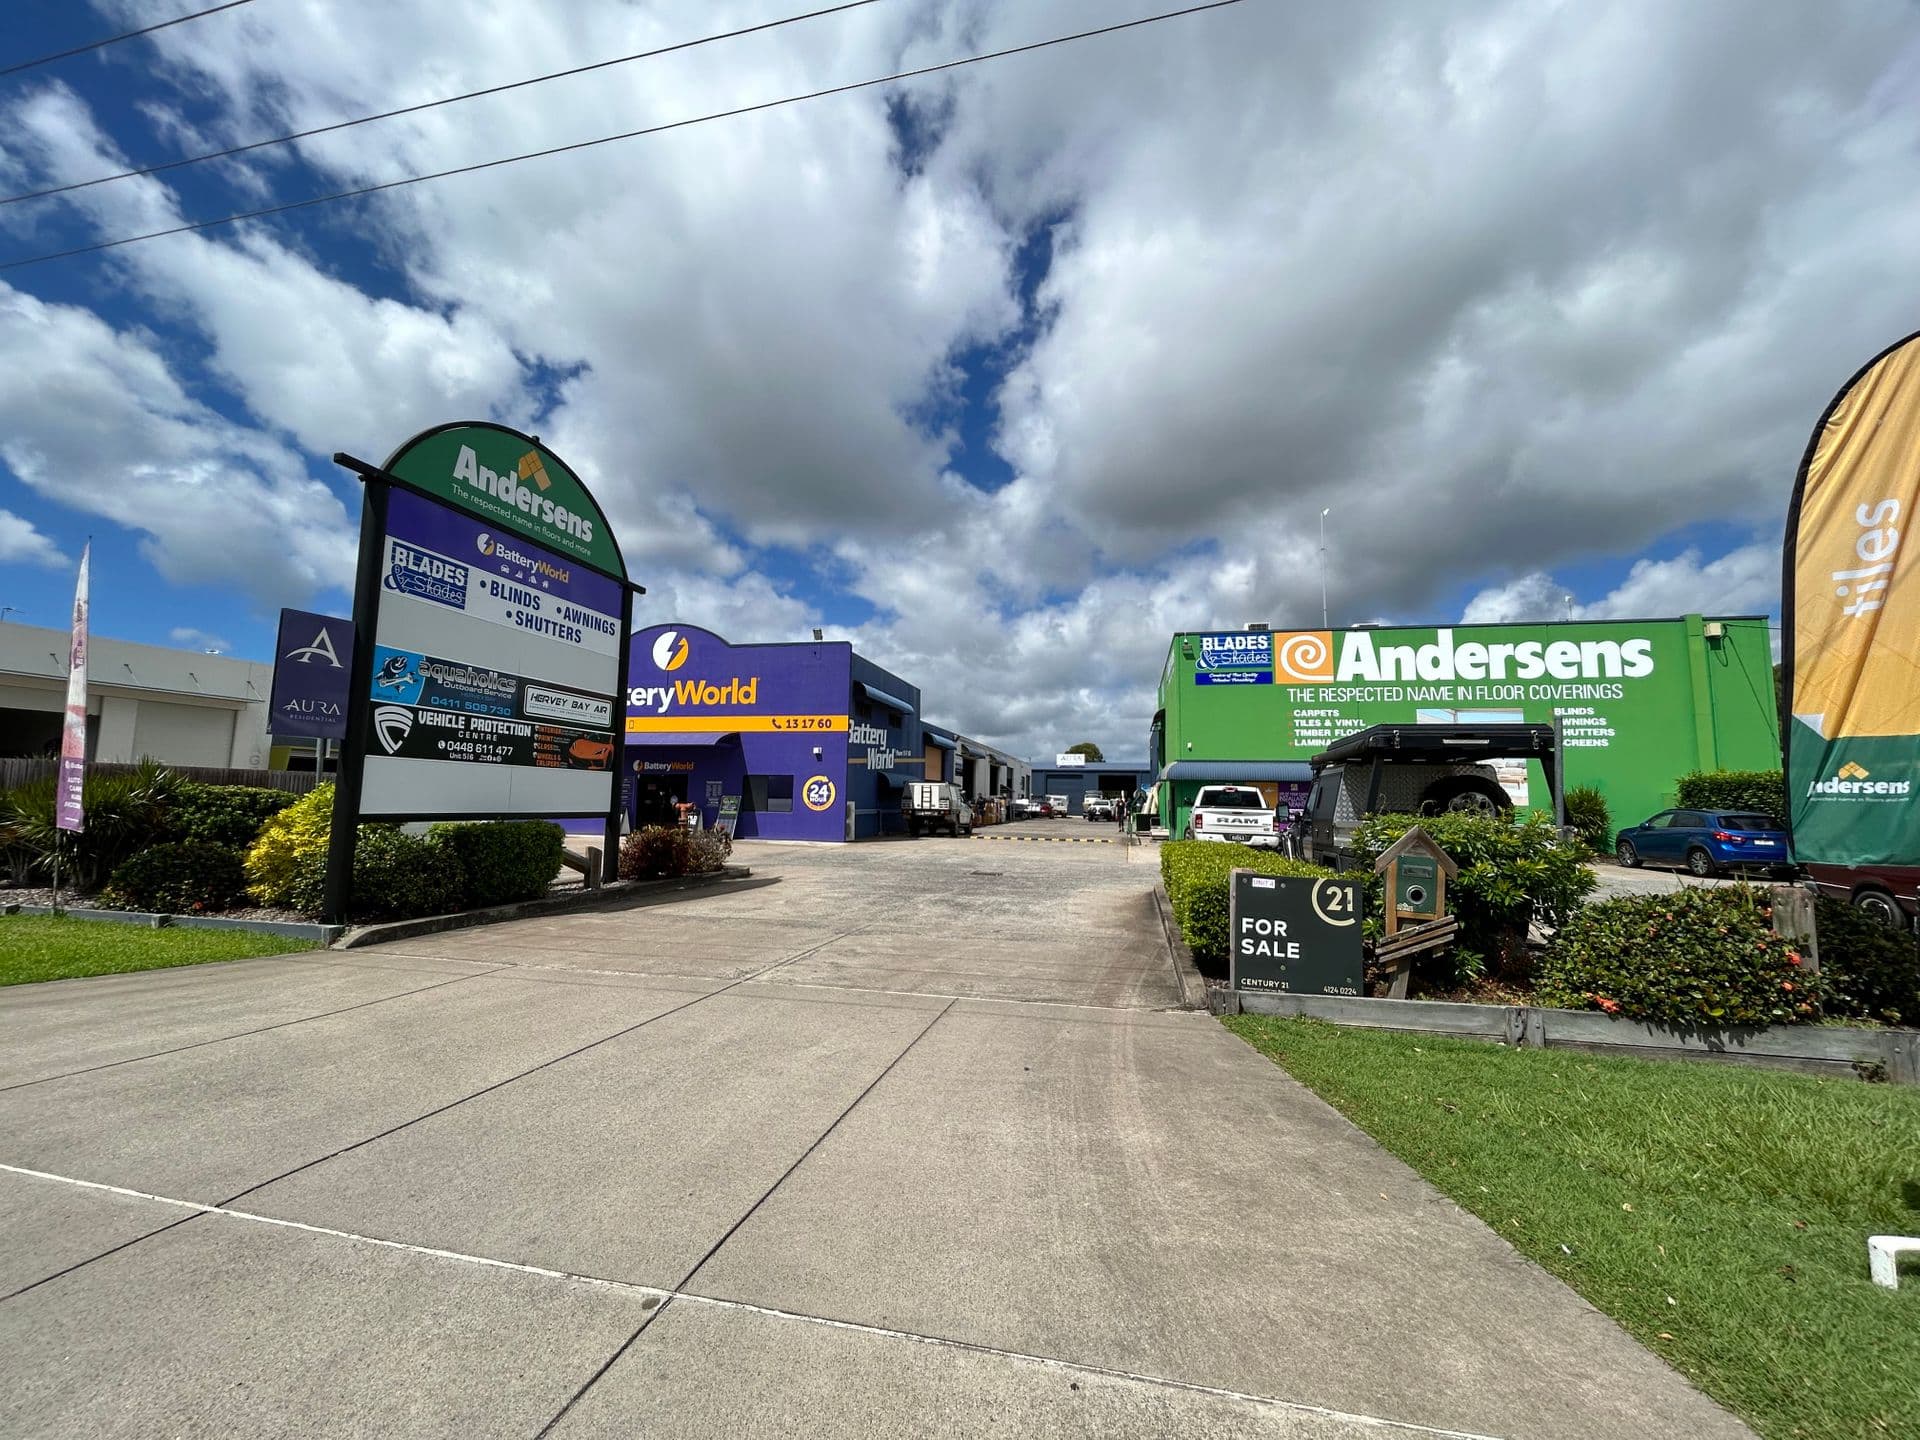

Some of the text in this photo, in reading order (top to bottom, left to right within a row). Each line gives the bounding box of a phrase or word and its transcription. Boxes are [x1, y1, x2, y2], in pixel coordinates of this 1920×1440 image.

[453, 444, 593, 542] Andersens
[452, 484, 592, 556] The respected name in floors and more
[394, 545, 466, 586] BLADES
[496, 543, 569, 583] BatteryWorld
[1832, 498, 1900, 618] tiles
[384, 563, 463, 603] & Shades
[490, 579, 616, 636] BLINDS AWNINGS
[515, 610, 582, 643] SHUTTERS
[1202, 635, 1268, 650] BLADES
[1195, 649, 1268, 671] & Shades
[1336, 628, 1654, 682] Andersens
[418, 661, 517, 693] aquaholics
[443, 681, 483, 694] Outboard
[483, 688, 512, 699] Service
[1287, 683, 1623, 703] THE RESPECTED NAME IN FLOOR COVERINGS
[282, 698, 341, 716] AURA
[431, 696, 460, 708] 0411
[464, 701, 488, 712] 509
[489, 705, 511, 716] 730
[530, 693, 568, 707] HERVEY
[571, 701, 590, 711] BAY
[593, 705, 608, 714] AIR
[1293, 709, 1339, 717] CARPETS
[1554, 707, 1595, 716] BLINDS
[418, 710, 532, 737] VEHICLE PROTECTION
[785, 718, 832, 729] 13 17 60
[1293, 719, 1366, 727] TILES & VINYL
[1562, 717, 1607, 726] WNINGS
[458, 730, 498, 741] CENTRE
[848, 719, 887, 750] Battery
[1294, 729, 1331, 737] TIMBER
[1562, 728, 1616, 737] HUTTERS
[1562, 738, 1609, 747] CREENS
[447, 740, 513, 756] 0448 611 477
[644, 761, 694, 772] BatteryWorld
[867, 747, 895, 770] World
[810, 784, 829, 798] 24
[1216, 817, 1258, 825] RAM
[1241, 917, 1287, 937] FOR
[1241, 938, 1300, 959] SALE
[1241, 977, 1289, 989] CENTURY 21
[1323, 985, 1357, 995] 4124 0224
